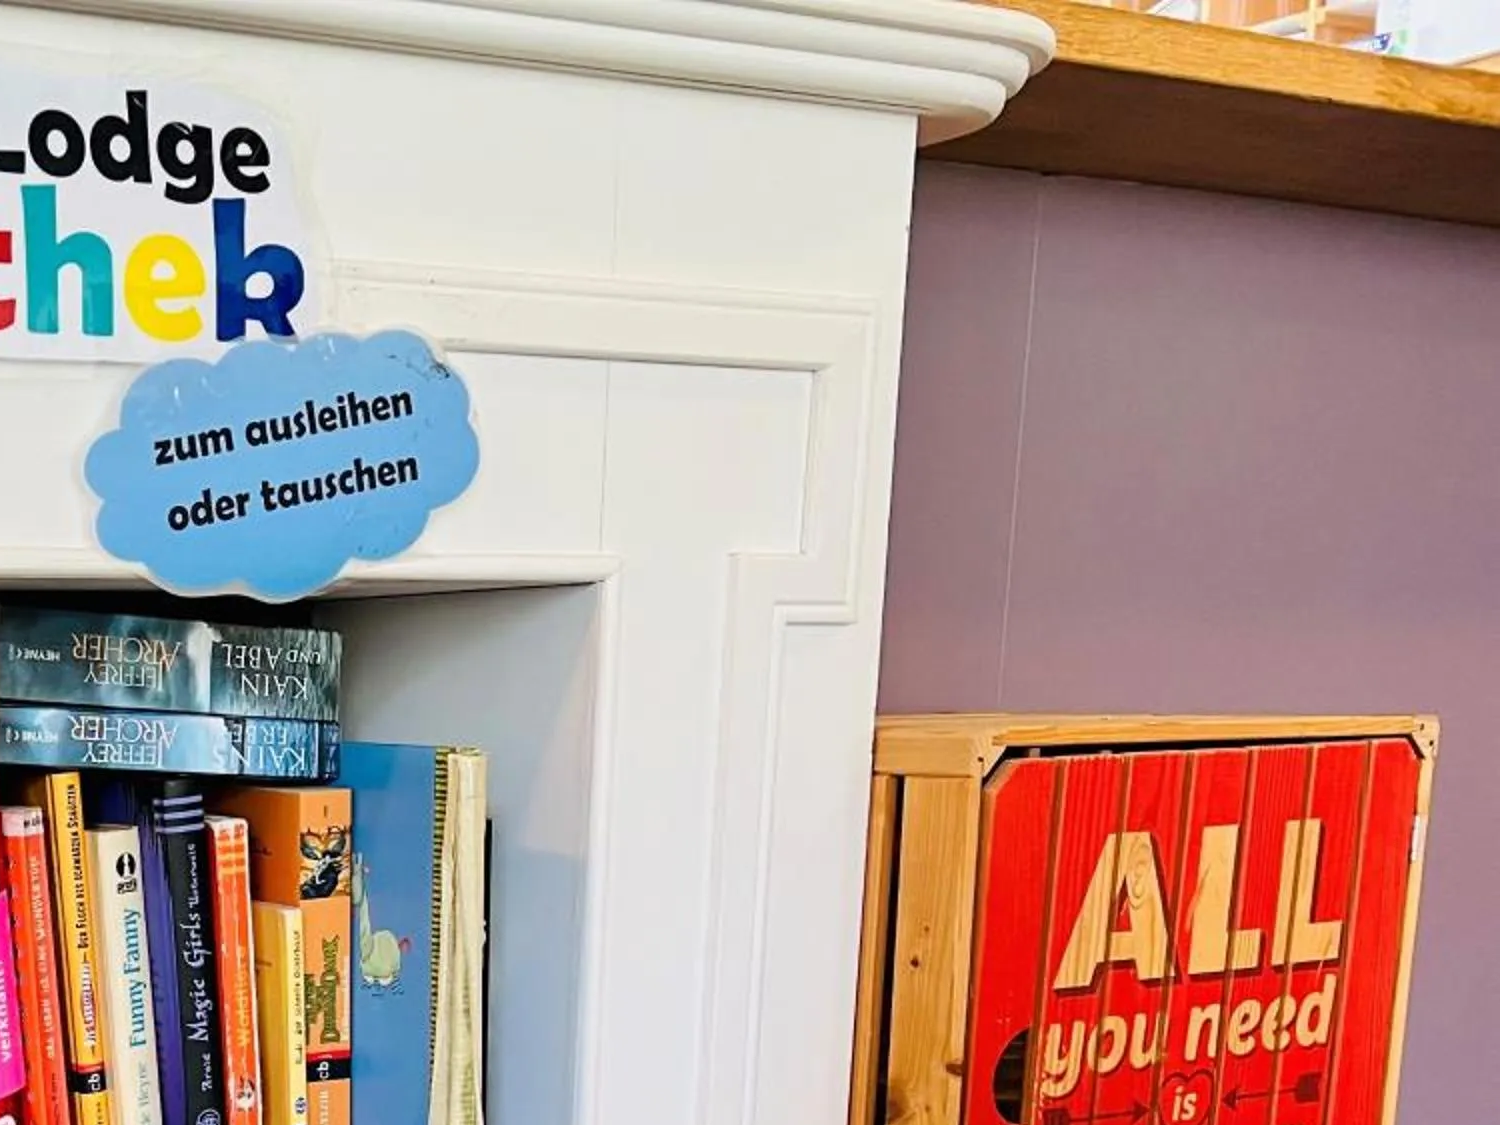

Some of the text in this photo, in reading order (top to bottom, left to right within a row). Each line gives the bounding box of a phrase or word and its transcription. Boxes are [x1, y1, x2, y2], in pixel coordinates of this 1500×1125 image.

[153, 391, 414, 466] zum ausleihen
[167, 456, 419, 531] oder tauschen
[26, 649, 60, 662] HEYNE
[70, 632, 182, 692] JEFFREY ARCHER
[222, 644, 323, 701] KAIN UND ABEL
[70, 715, 178, 770] JEFFREY ARCHER
[212, 723, 308, 773] KAINS ERBE
[1052, 818, 1344, 992] ALL
[123, 908, 141, 976] Fanny
[179, 911, 214, 1042] Magic Girls
[128, 977, 148, 1050] Funny
[1038, 974, 1337, 1100] you need
[1171, 1085, 1197, 1123] is
